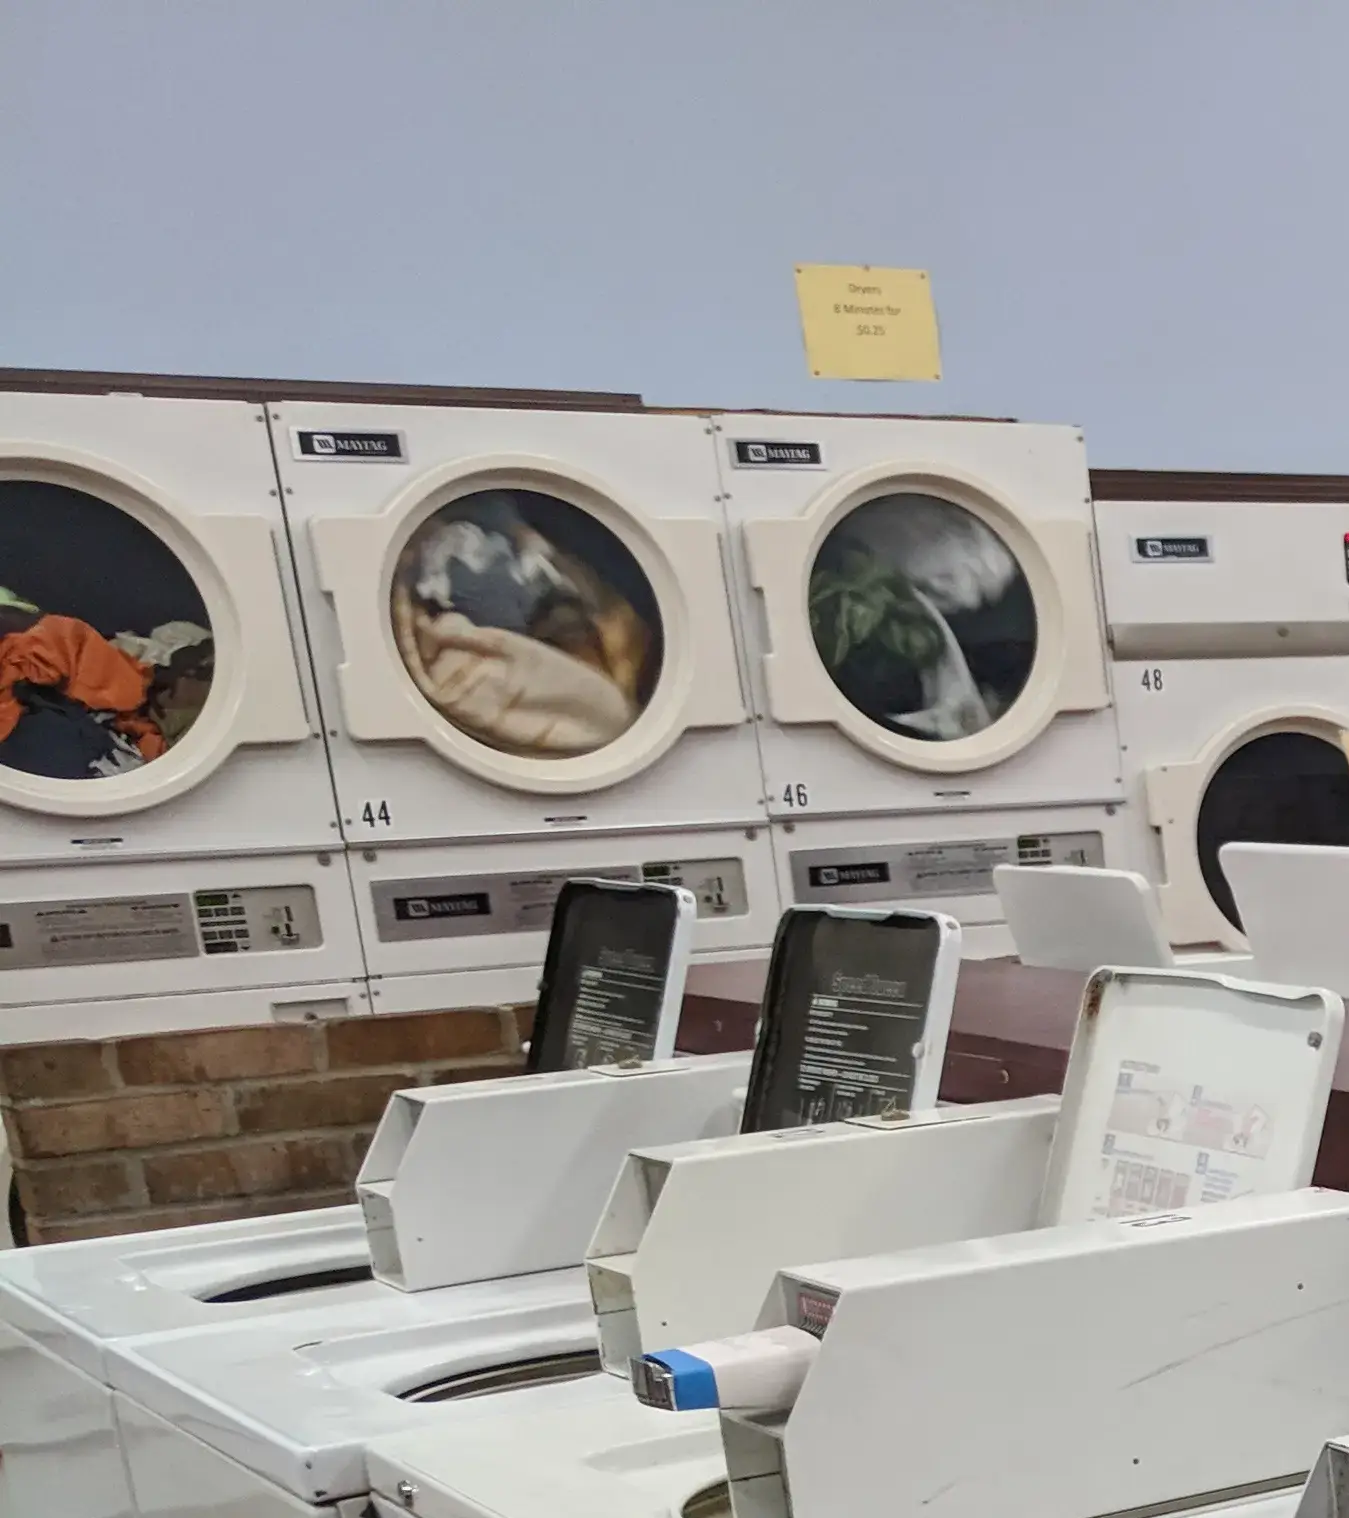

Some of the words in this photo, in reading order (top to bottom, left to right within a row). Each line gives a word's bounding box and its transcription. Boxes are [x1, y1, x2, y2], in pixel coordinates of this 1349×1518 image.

[337, 439, 388, 453] MAYTAG
[768, 446, 810, 460] MAYTAG
[1141, 668, 1163, 691] 48
[784, 783, 808, 807] 46
[362, 800, 391, 826] 44
